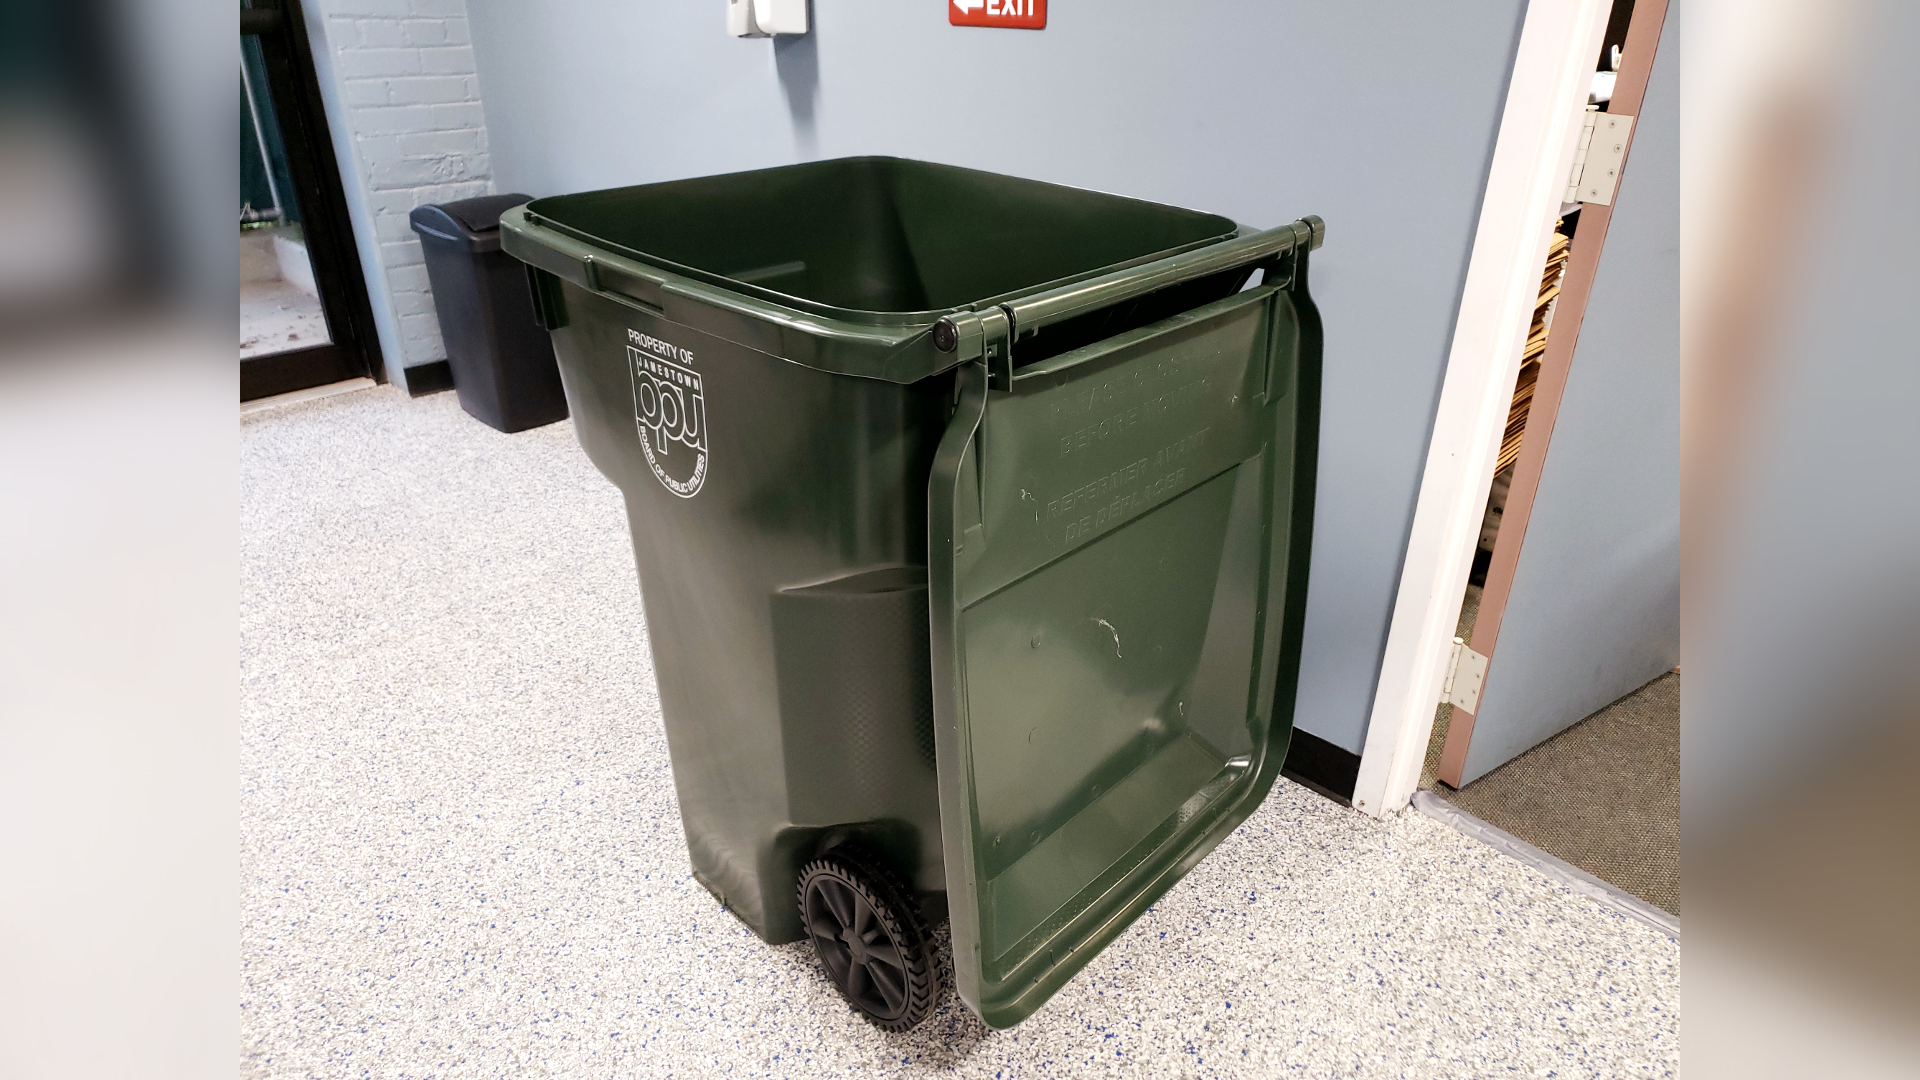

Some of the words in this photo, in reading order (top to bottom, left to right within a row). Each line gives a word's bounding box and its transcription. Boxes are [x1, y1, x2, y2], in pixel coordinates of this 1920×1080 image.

[987, 0, 1034, 16] EXIT
[627, 328, 678, 360] PROPERTY
[679, 348, 694, 366] OF
[638, 356, 700, 391] JAMESTOWN
[1050, 377, 1127, 420] PLEASE
[1060, 406, 1138, 459] BEFORE
[1143, 376, 1213, 423] MOVING
[640, 425, 656, 464] BOARD
[655, 463, 666, 477] OF
[665, 474, 688, 494] PUBLIC
[687, 453, 706, 493] UTILITIES
[1047, 457, 1148, 522] REFERMER
[1153, 426, 1212, 470] AVANT
[1065, 515, 1091, 545] DE
[1096, 467, 1187, 529] DÉPLACER
